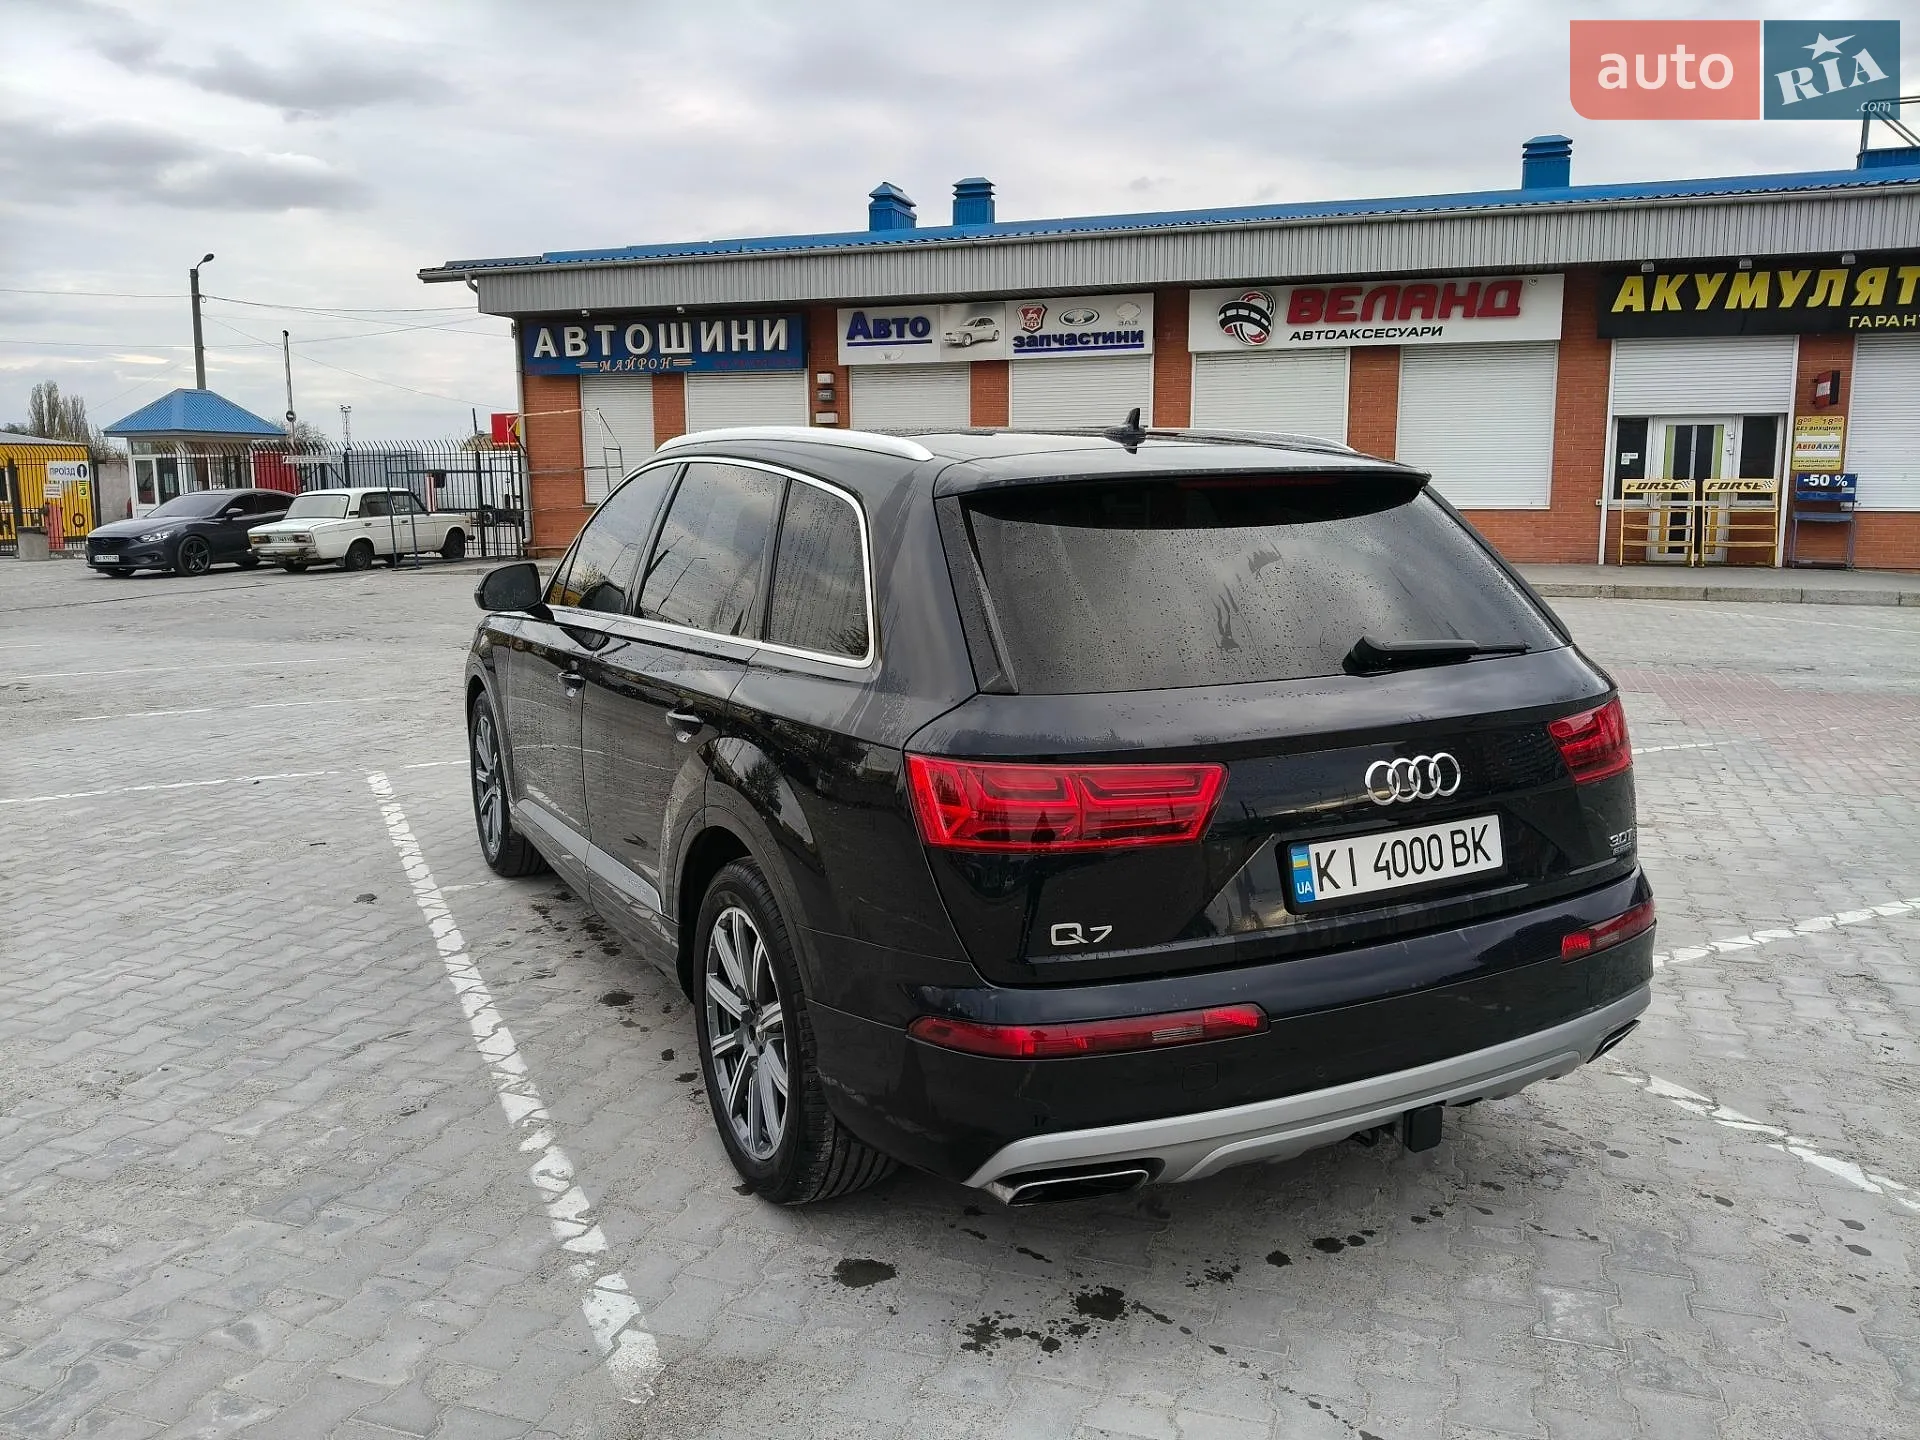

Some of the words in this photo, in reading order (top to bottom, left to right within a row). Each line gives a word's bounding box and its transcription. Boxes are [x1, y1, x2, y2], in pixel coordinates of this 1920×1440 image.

[1611, 265, 1920, 313] АКУМУЛЯТ
[1286, 280, 1524, 325] ВЕЛАНД
[1848, 314, 1920, 328] ГАРАН
[533, 317, 790, 359] АВТОШИНИ
[1289, 325, 1444, 342] АВТОАКСЕСУАРИ
[599, 356, 673, 373] МАЙРОН
[1803, 474, 1830, 487] -50
[1834, 474, 1848, 487] %
[1373, 833, 1444, 881] 4000
[1450, 824, 1492, 868] BK
[1296, 881, 1313, 895] UA
[1050, 922, 1113, 946] Q7
